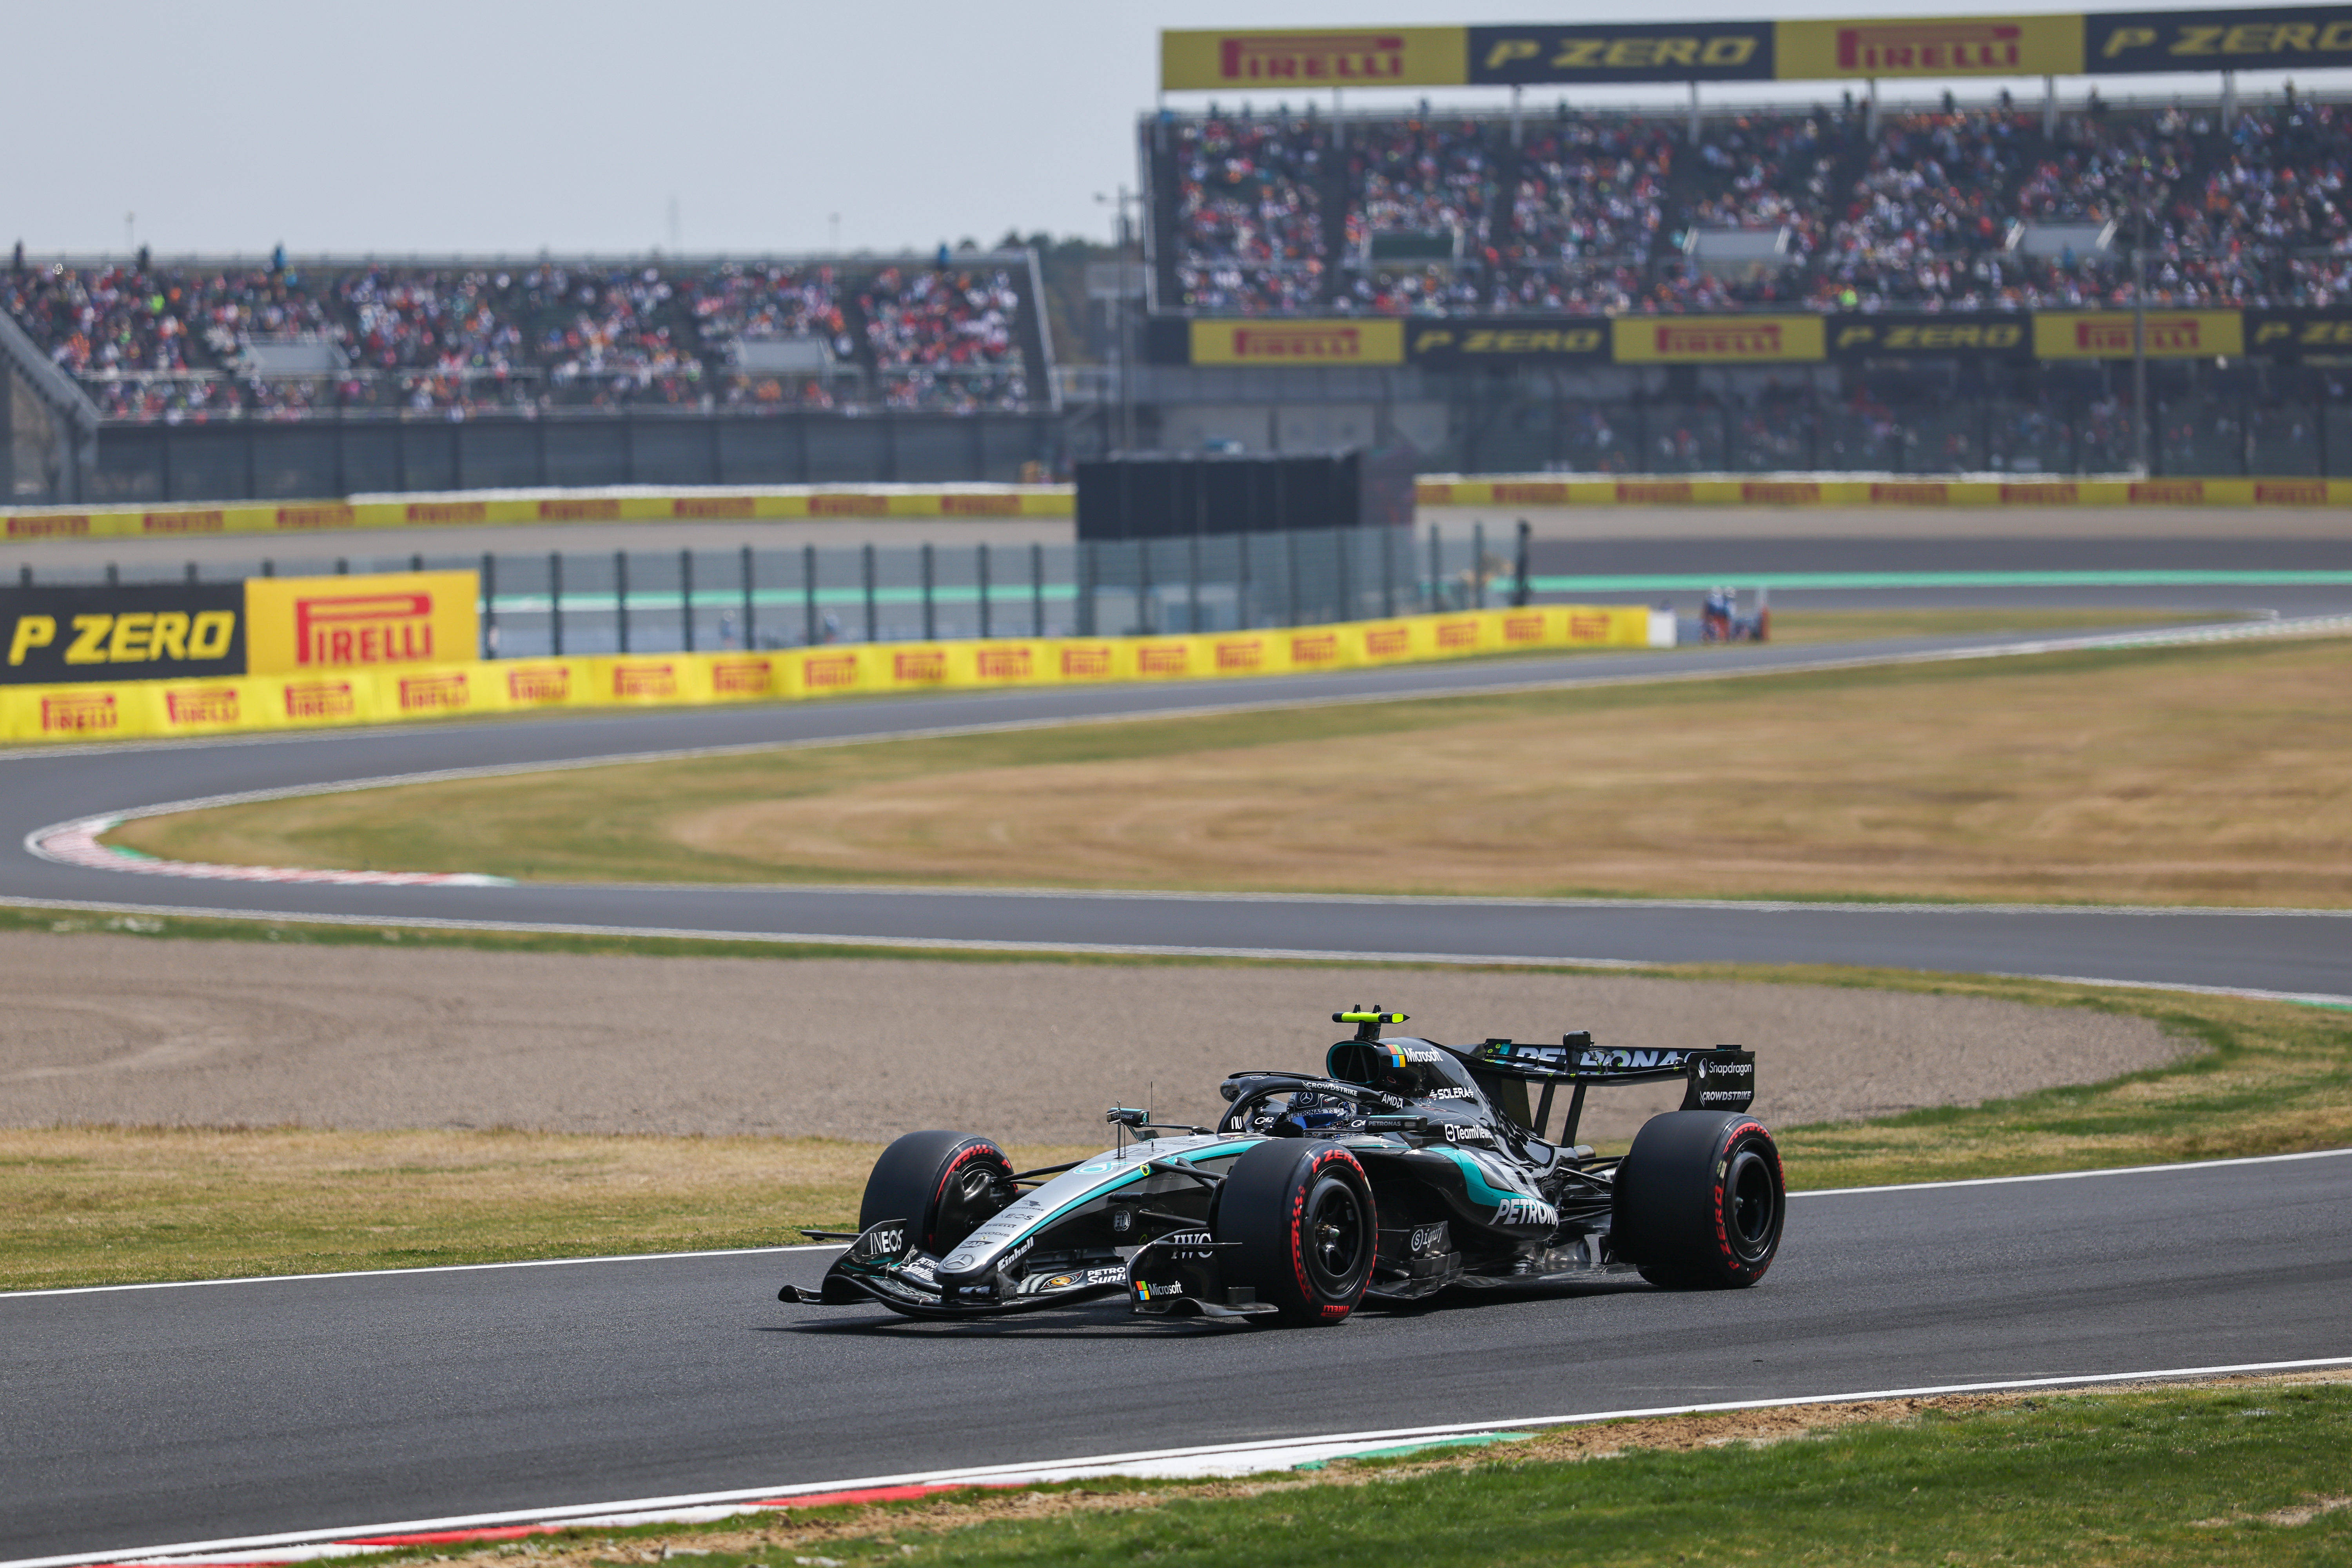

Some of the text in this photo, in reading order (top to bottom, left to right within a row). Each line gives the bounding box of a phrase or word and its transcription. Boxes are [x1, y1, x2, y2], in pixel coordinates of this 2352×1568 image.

[1486, 37, 1757, 67] P ZERO
[1837, 24, 2020, 69] PIRELLI
[2102, 27, 2155, 58] P
[1219, 36, 1404, 78] PIRELLI
[8, 610, 235, 666] P ZERO
[295, 592, 432, 666] PIRELLI
[1403, 1047, 1443, 1062] Microsoft
[1709, 1061, 1752, 1076] Snapdragon
[1306, 1082, 1357, 1097] CROWDSTRIKE
[1437, 1087, 1469, 1099] SOLERA
[1703, 1091, 1751, 1101] CROWDSTRIKE
[1381, 1093, 1397, 1107] AMD
[1292, 1109, 1323, 1117] PETRONAS
[1312, 1149, 1365, 1174] P ZERO
[869, 1229, 904, 1254] INEOS
[1171, 1232, 1213, 1259] IWC
[997, 1236, 1034, 1272] Einhell
[1728, 1260, 1740, 1270] P
[1148, 1280, 1183, 1296] Microsoft
[1321, 1305, 1350, 1317] PIRELLI
